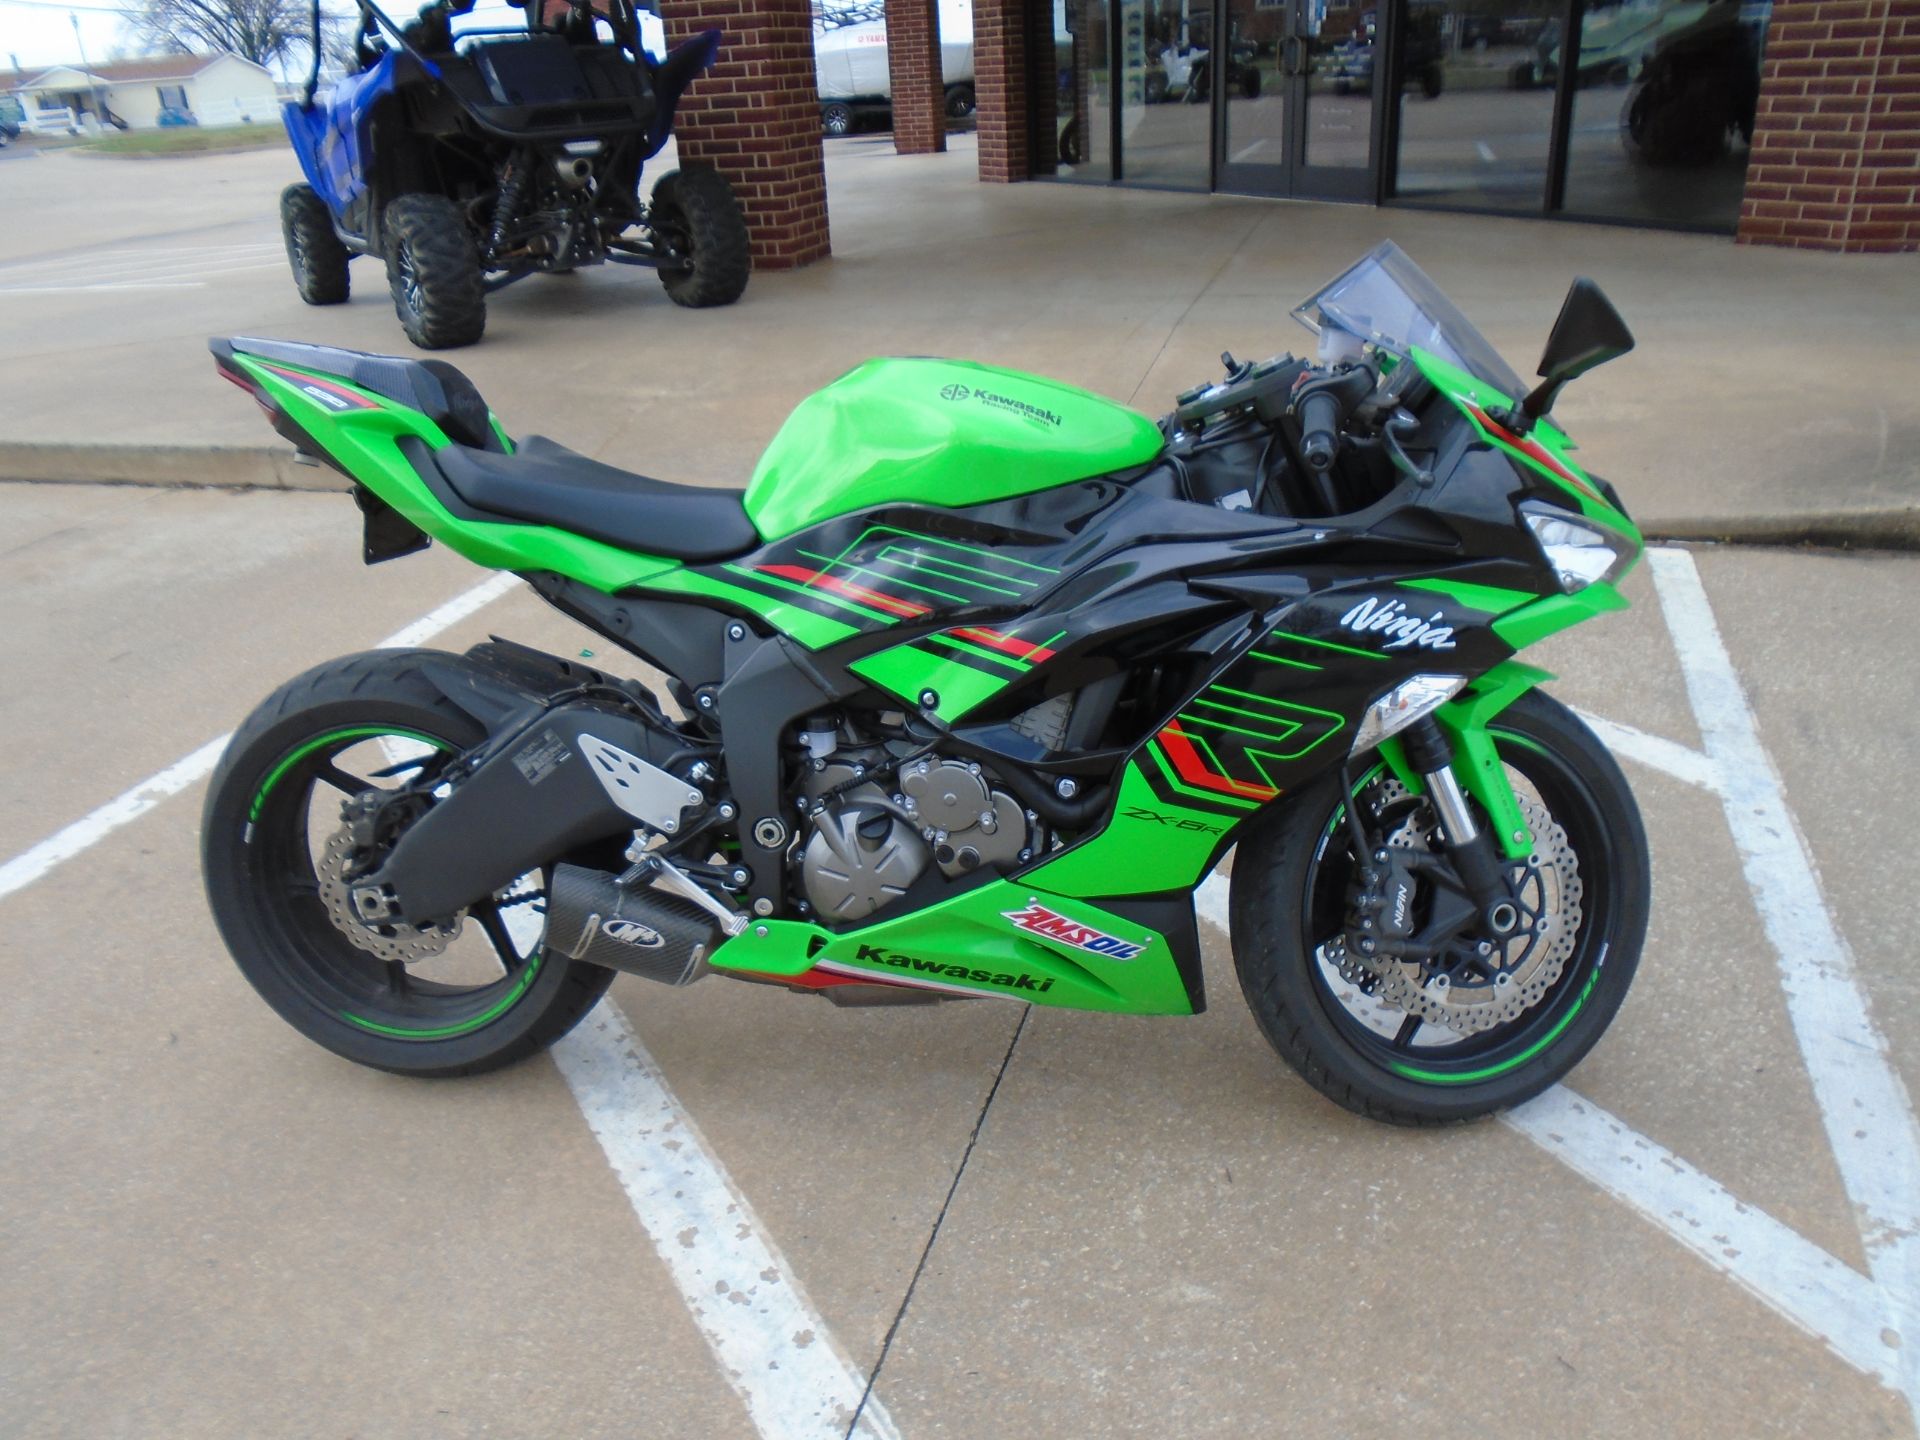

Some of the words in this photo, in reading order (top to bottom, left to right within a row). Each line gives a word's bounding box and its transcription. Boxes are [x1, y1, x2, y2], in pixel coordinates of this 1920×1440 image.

[973, 388, 1062, 426] Kawasaki
[1340, 597, 1457, 648] Ninja
[1120, 806, 1225, 836] ZX-6R
[1001, 904, 1147, 960] AMSOIL
[855, 944, 1056, 993] Kawasaki
